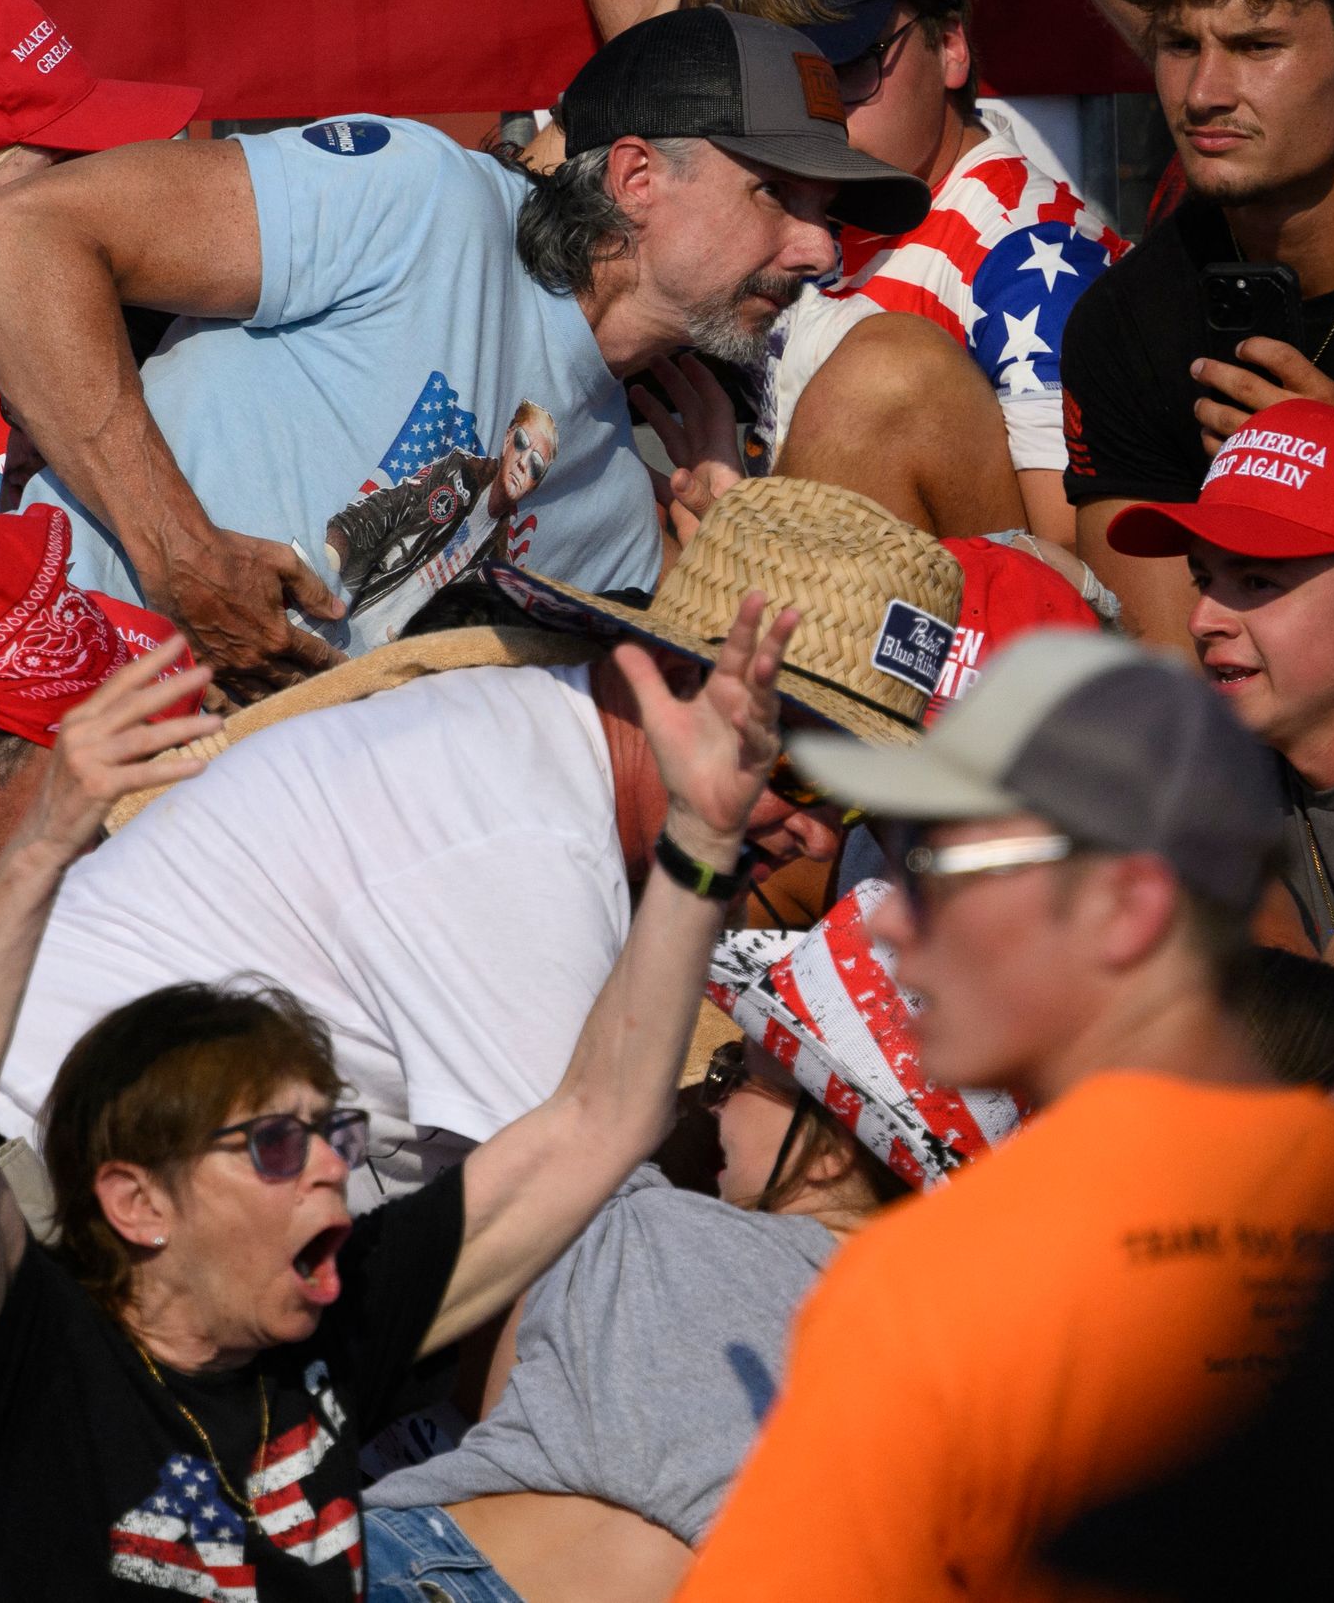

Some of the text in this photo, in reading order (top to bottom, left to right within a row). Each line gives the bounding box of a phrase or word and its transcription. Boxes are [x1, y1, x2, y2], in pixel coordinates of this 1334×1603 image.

[11, 20, 55, 63] MAKE
[1233, 428, 1327, 468] AMERICA
[1235, 455, 1311, 491] AGAIN
[880, 635, 915, 666] Blue
[908, 616, 946, 657] Pabst
